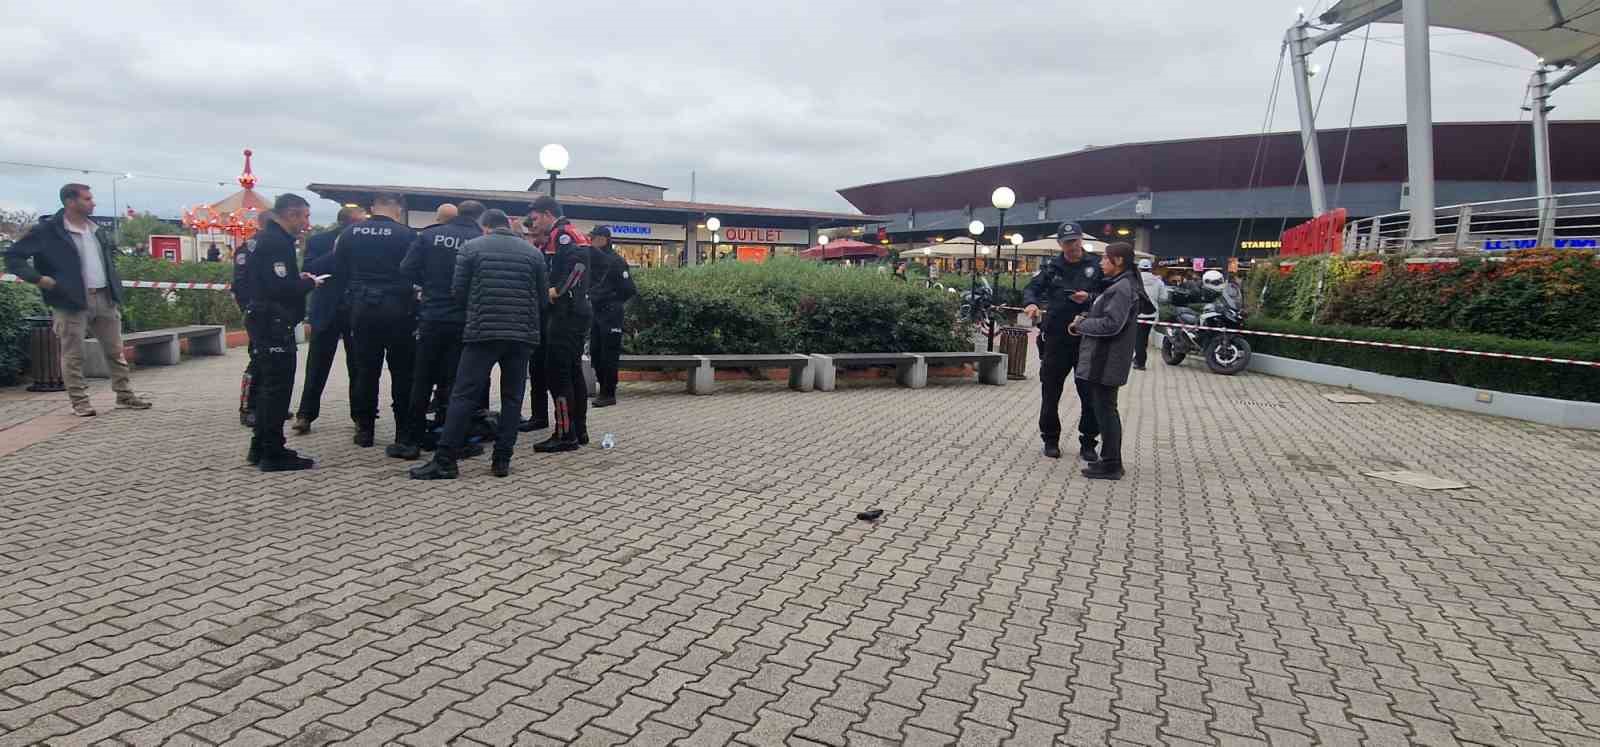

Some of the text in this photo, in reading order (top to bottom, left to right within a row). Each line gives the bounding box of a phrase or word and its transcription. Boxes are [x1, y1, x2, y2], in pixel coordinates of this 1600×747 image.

[353, 227, 392, 235] POLIS
[726, 228, 784, 242] OUTLET
[434, 235, 470, 249] POL
